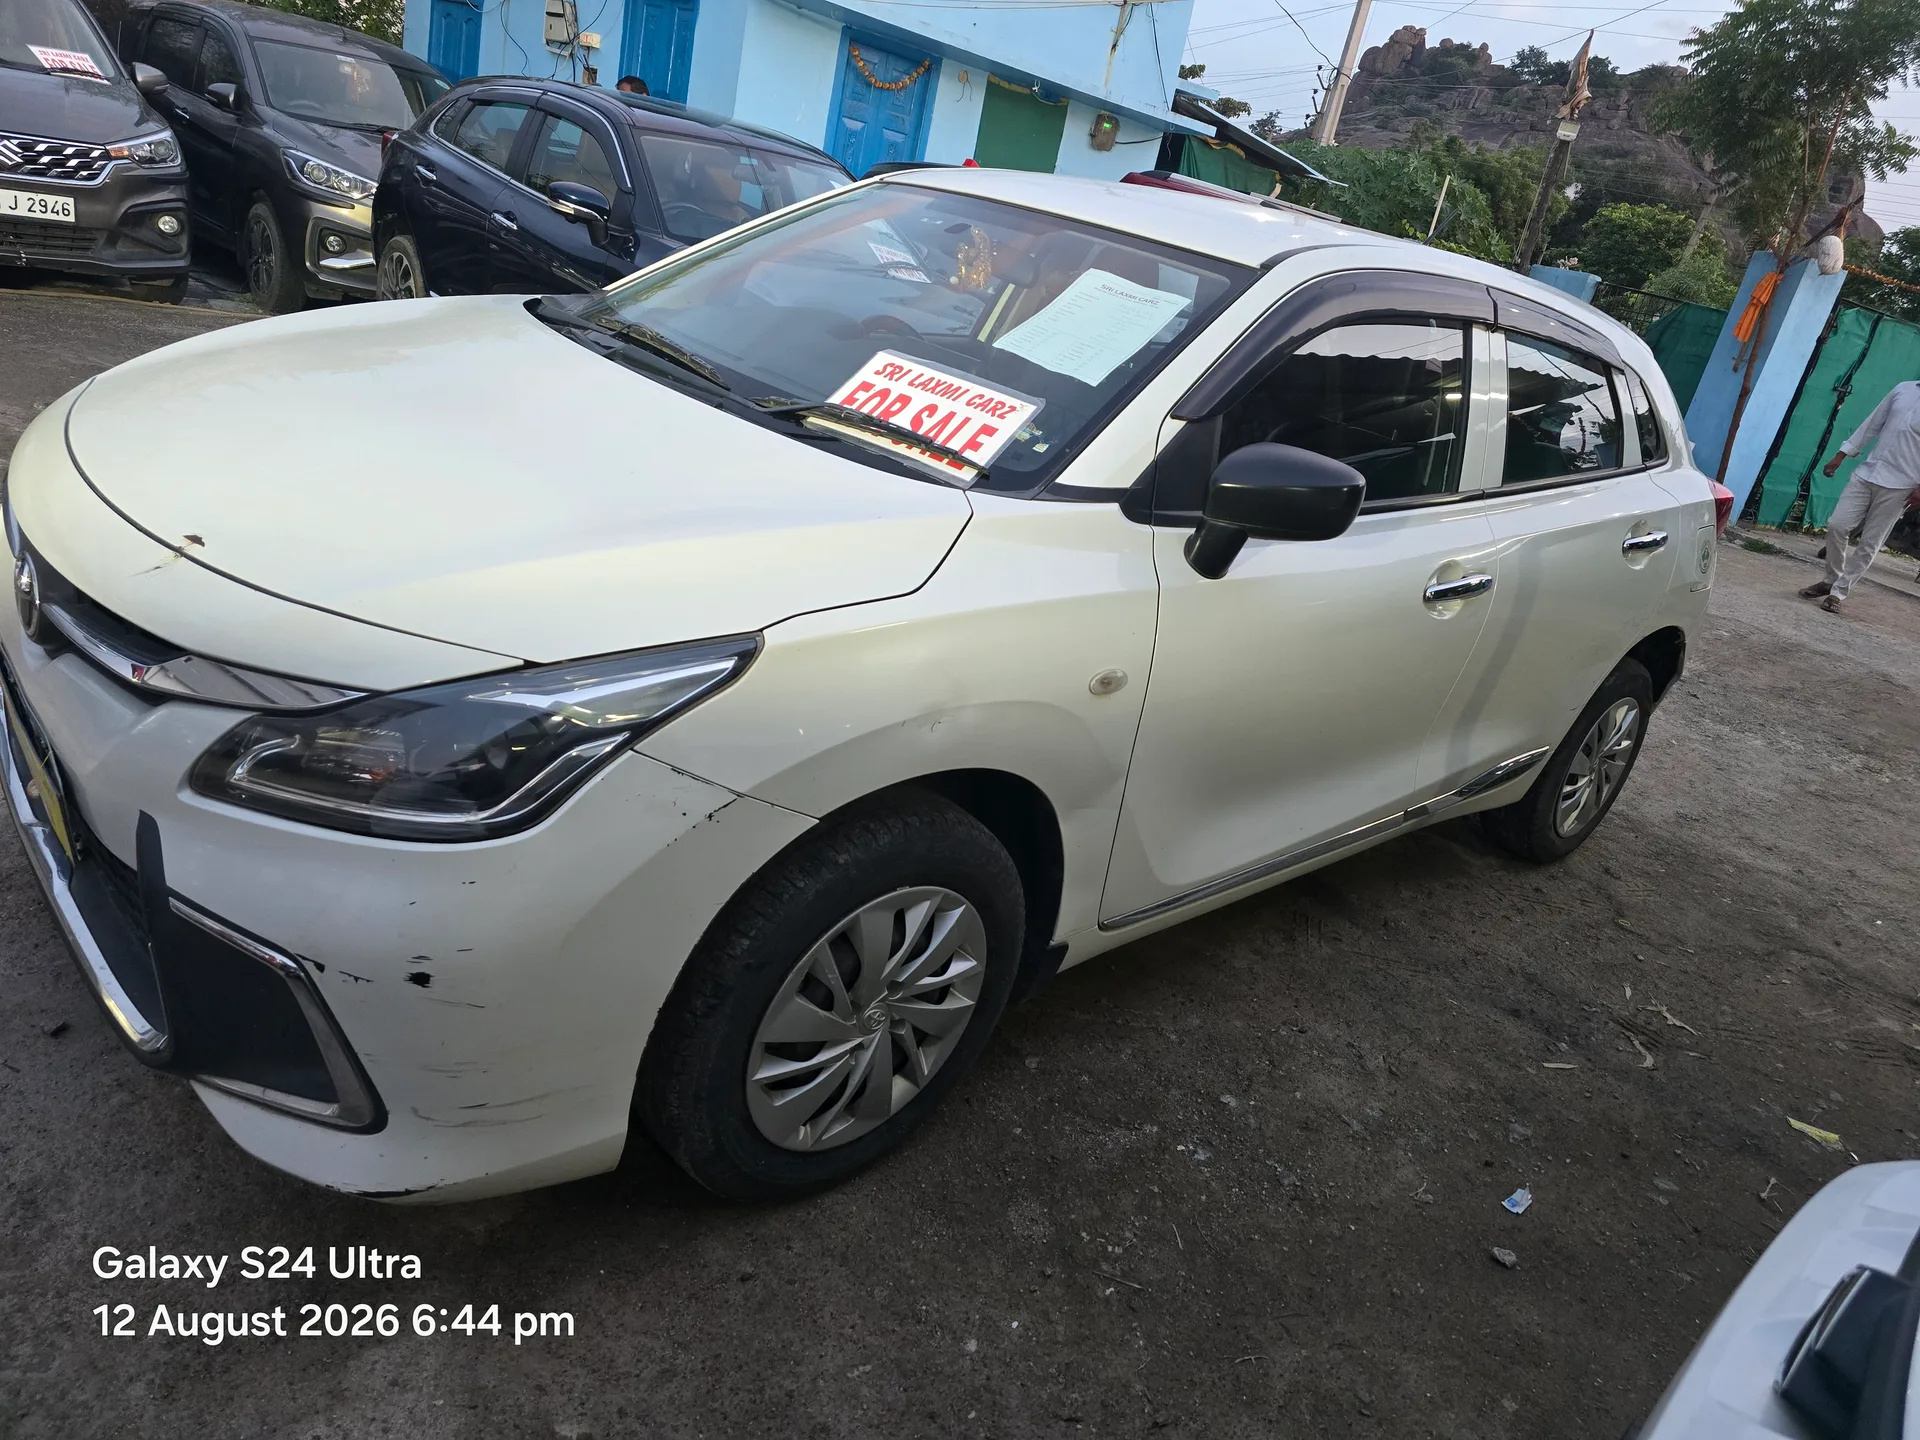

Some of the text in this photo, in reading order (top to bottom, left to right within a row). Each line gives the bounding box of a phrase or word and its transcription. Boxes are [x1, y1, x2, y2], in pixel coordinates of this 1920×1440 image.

[27, 197, 71, 217] 2946
[1100, 283, 1115, 293] SRI
[1114, 288, 1138, 301] LAXMI
[1137, 295, 1160, 306] CARZ
[873, 362, 1018, 420] SRI LAXMI CARZ
[838, 380, 999, 471] FOR SALE
